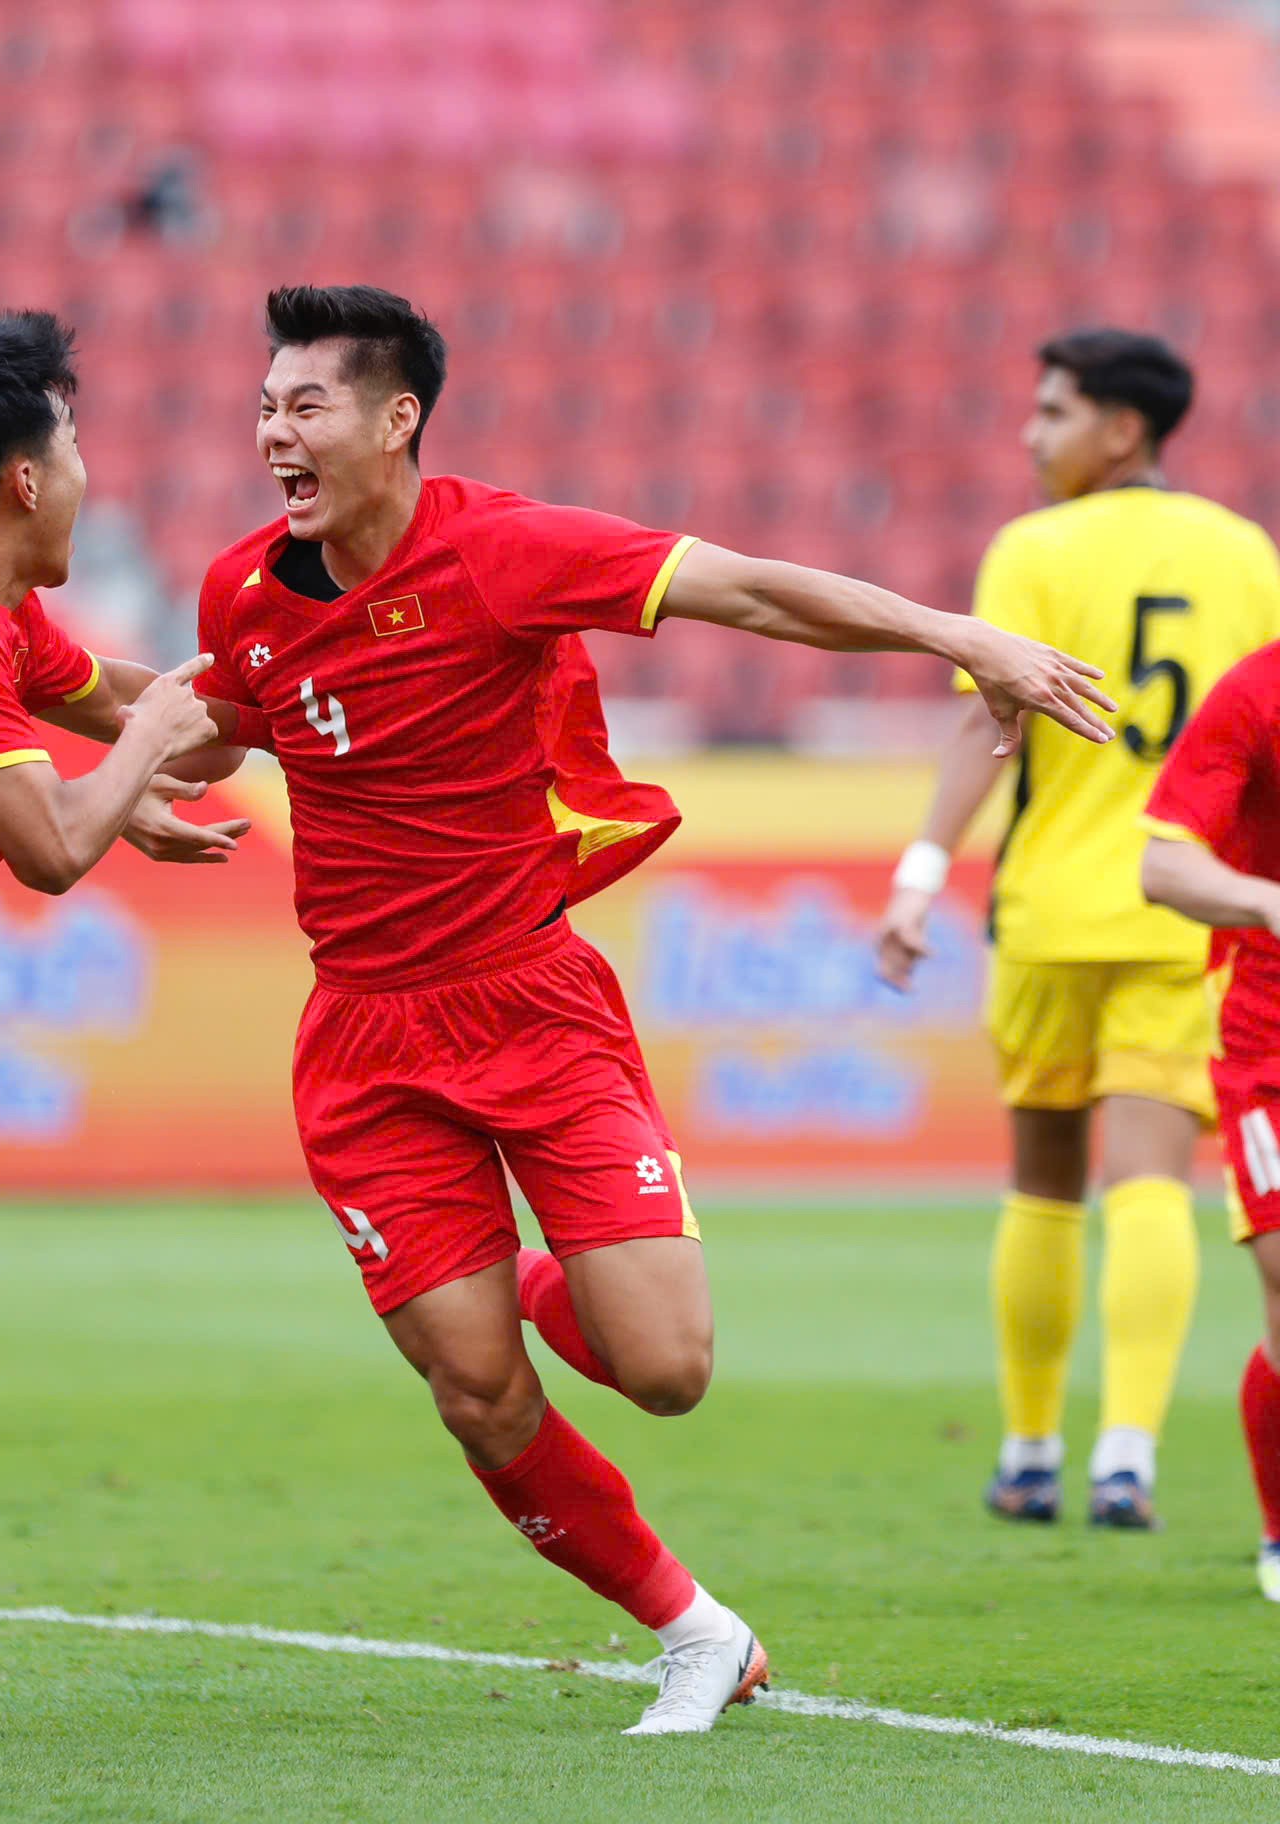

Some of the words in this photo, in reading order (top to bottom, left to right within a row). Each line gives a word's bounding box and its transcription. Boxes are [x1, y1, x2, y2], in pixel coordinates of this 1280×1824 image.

[299, 676, 351, 757] 4
[1123, 594, 1192, 763] 5
[321, 1195, 390, 1262] 4
